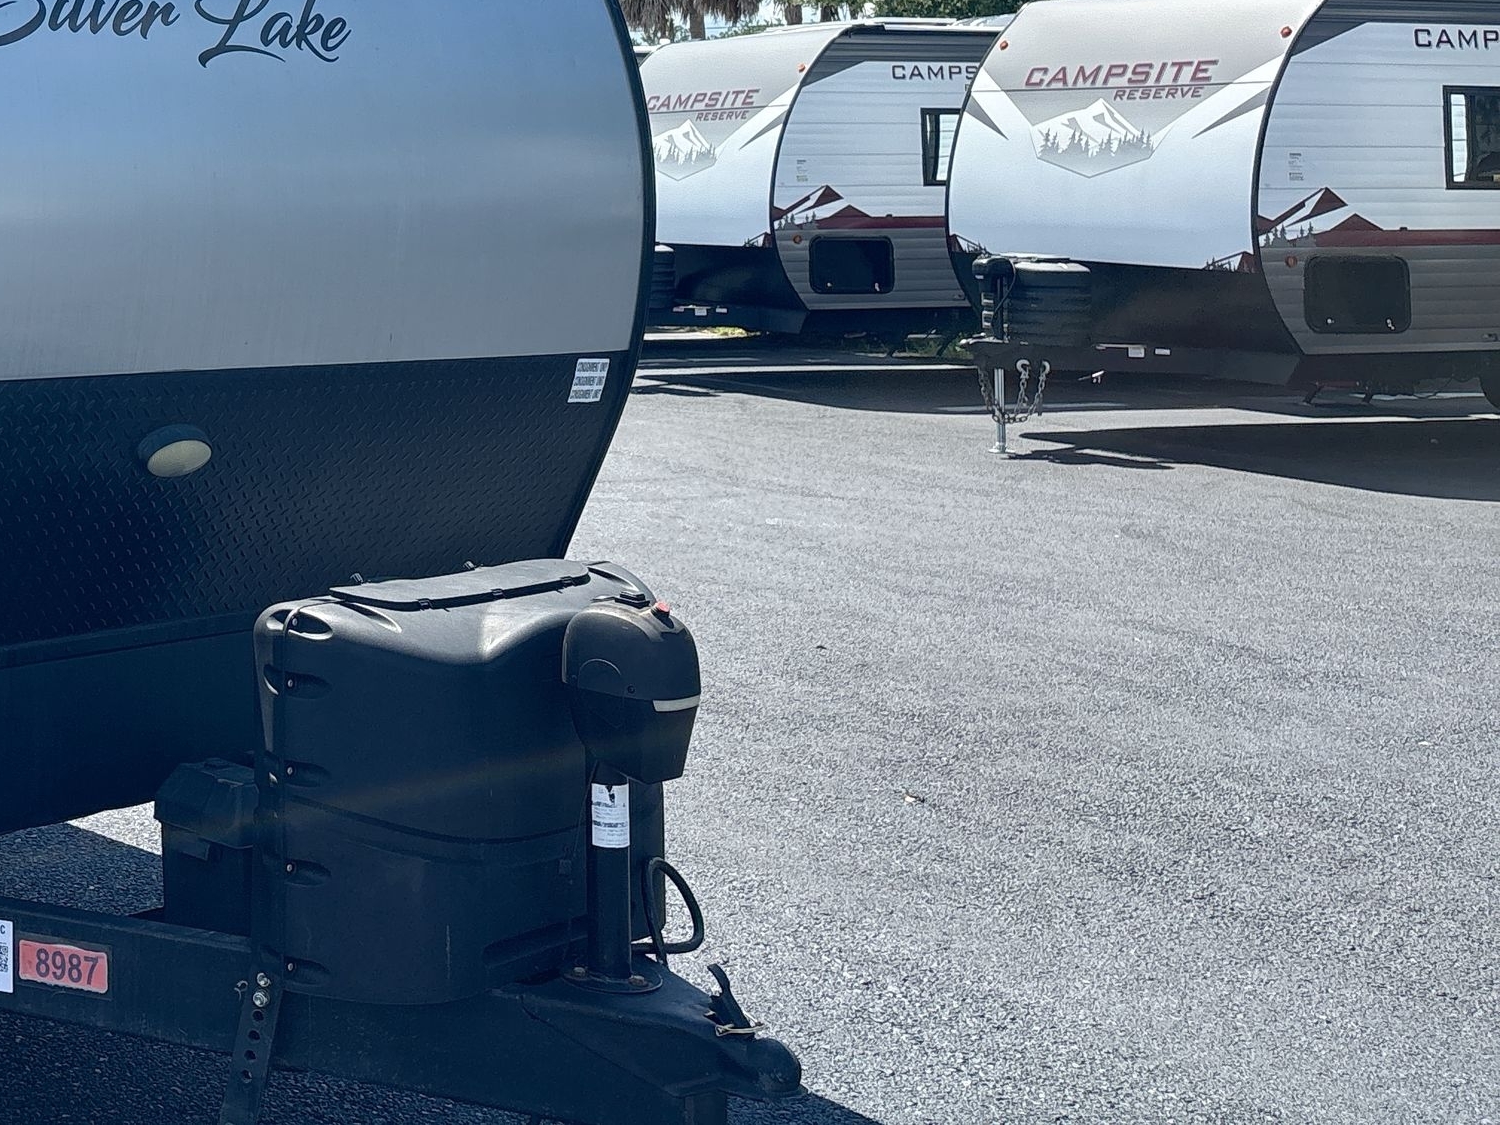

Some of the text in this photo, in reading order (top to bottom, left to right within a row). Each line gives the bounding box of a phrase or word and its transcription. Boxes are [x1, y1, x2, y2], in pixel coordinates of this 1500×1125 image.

[1414, 28, 1500, 50] CAMP
[1025, 59, 1219, 88] CAMPSITE
[647, 88, 761, 112] CAMPSITE
[1112, 86, 1205, 101] RESERVE
[695, 110, 750, 122] RESERVE
[0, 924, 6, 935] C
[35, 947, 99, 986] 8987
